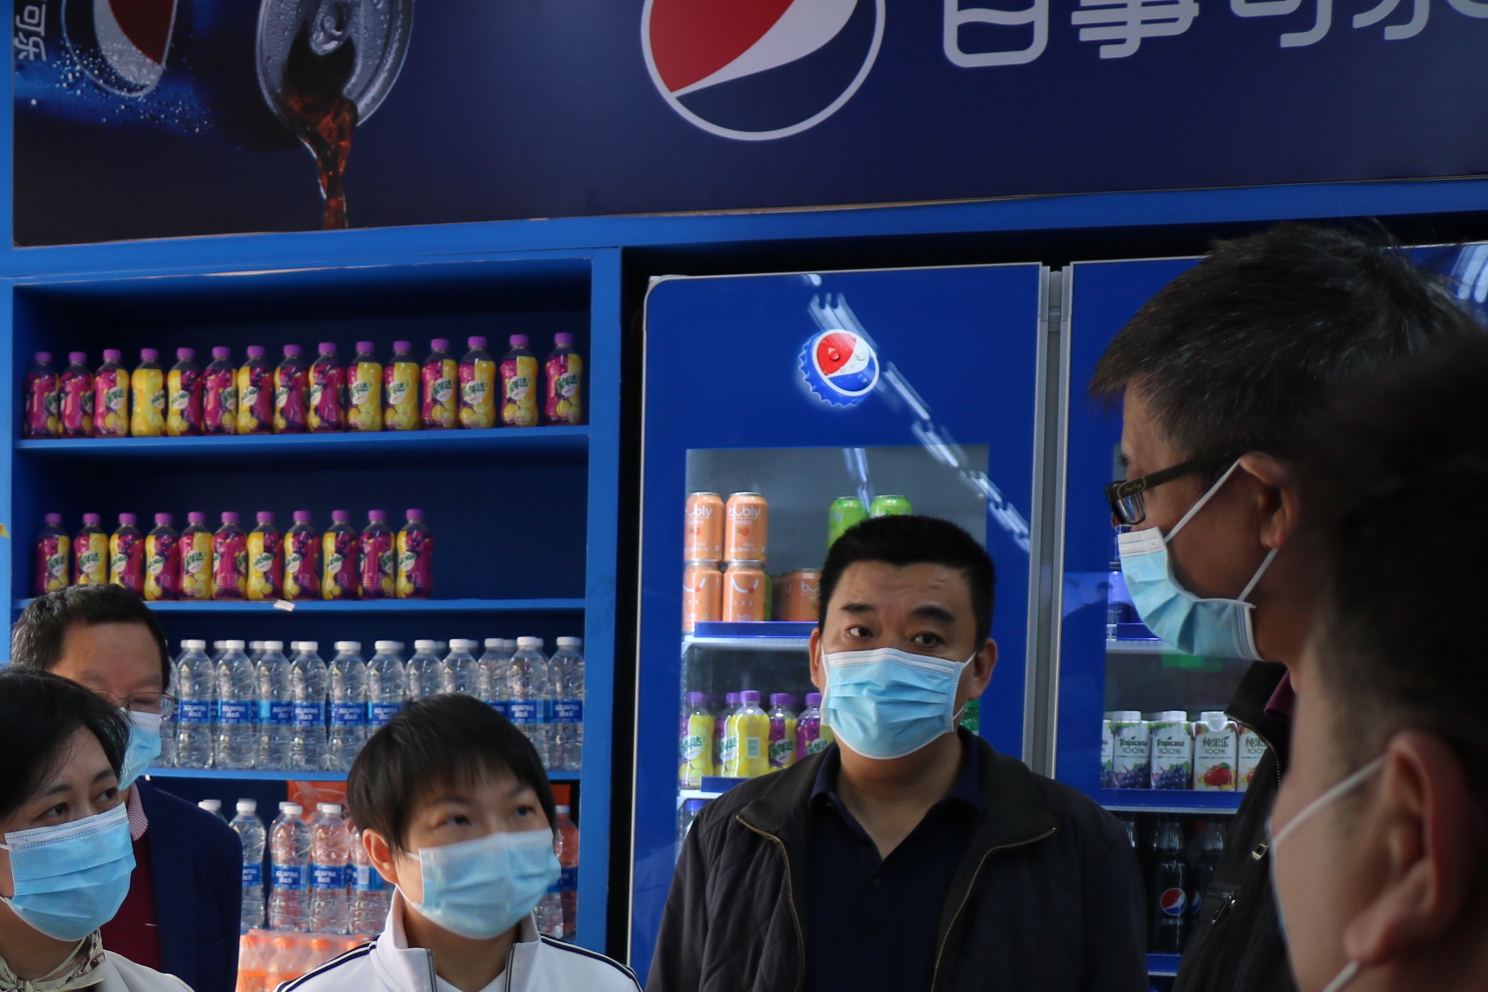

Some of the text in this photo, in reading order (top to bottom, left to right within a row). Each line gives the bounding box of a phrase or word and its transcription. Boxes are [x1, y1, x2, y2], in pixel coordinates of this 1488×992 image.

[1122, 747, 1146, 755] 100%
[1158, 747, 1182, 755] 100%
[1204, 747, 1227, 755] 100%
